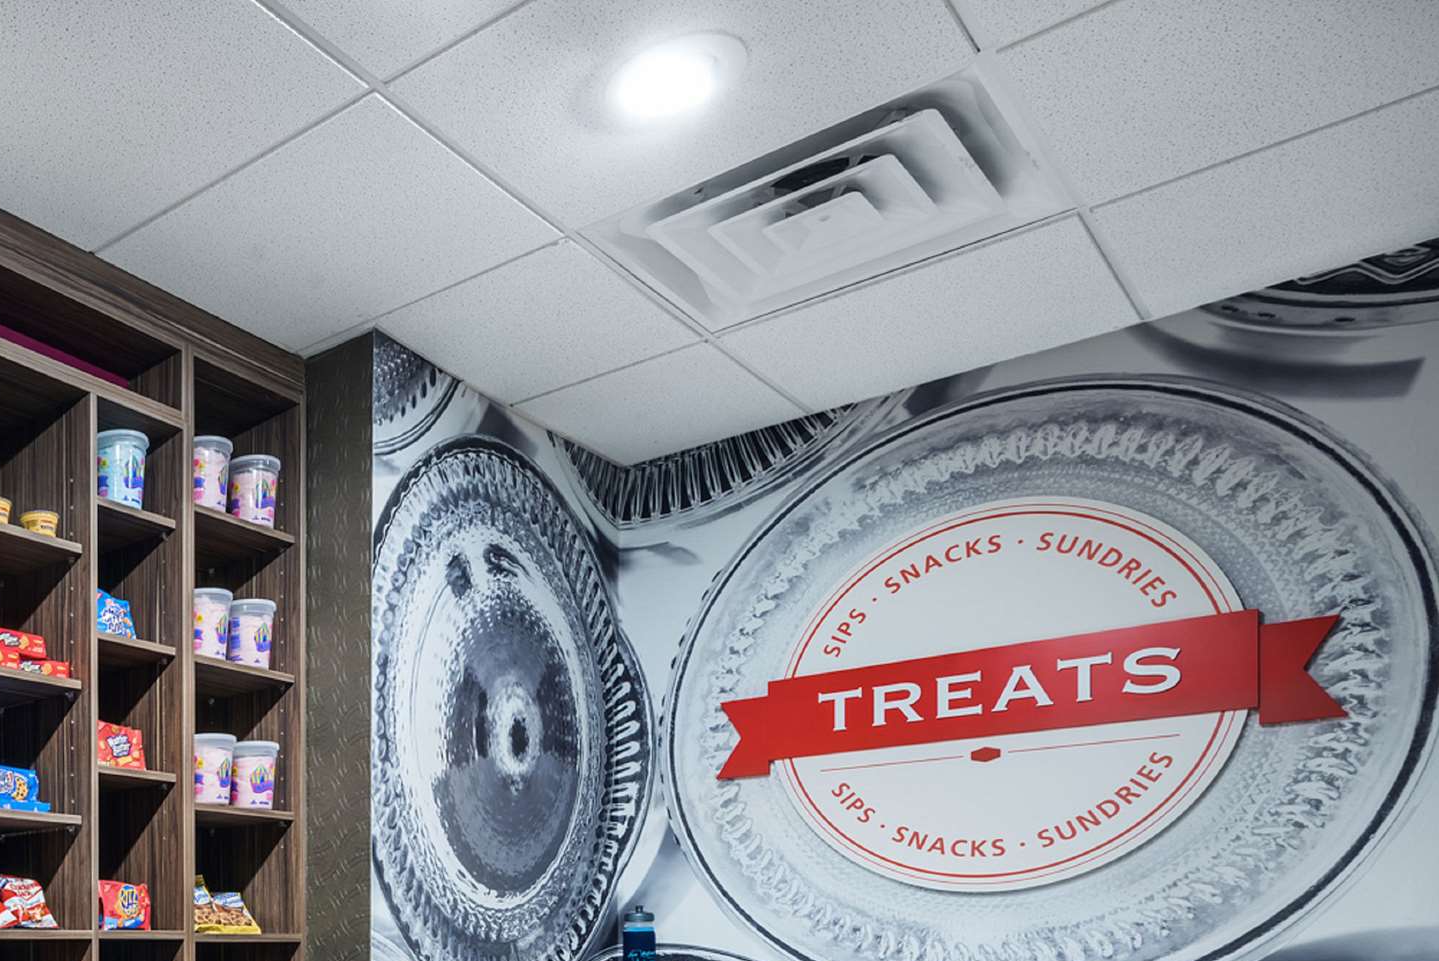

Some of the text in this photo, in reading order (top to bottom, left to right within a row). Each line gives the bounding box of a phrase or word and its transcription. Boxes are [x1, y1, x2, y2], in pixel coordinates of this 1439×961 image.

[824, 531, 1177, 657] SIPS SNACKS SUNDRIES
[817, 646, 1183, 733] TREATS
[831, 751, 1174, 857] SIPS SNACKS SUNDRIES
